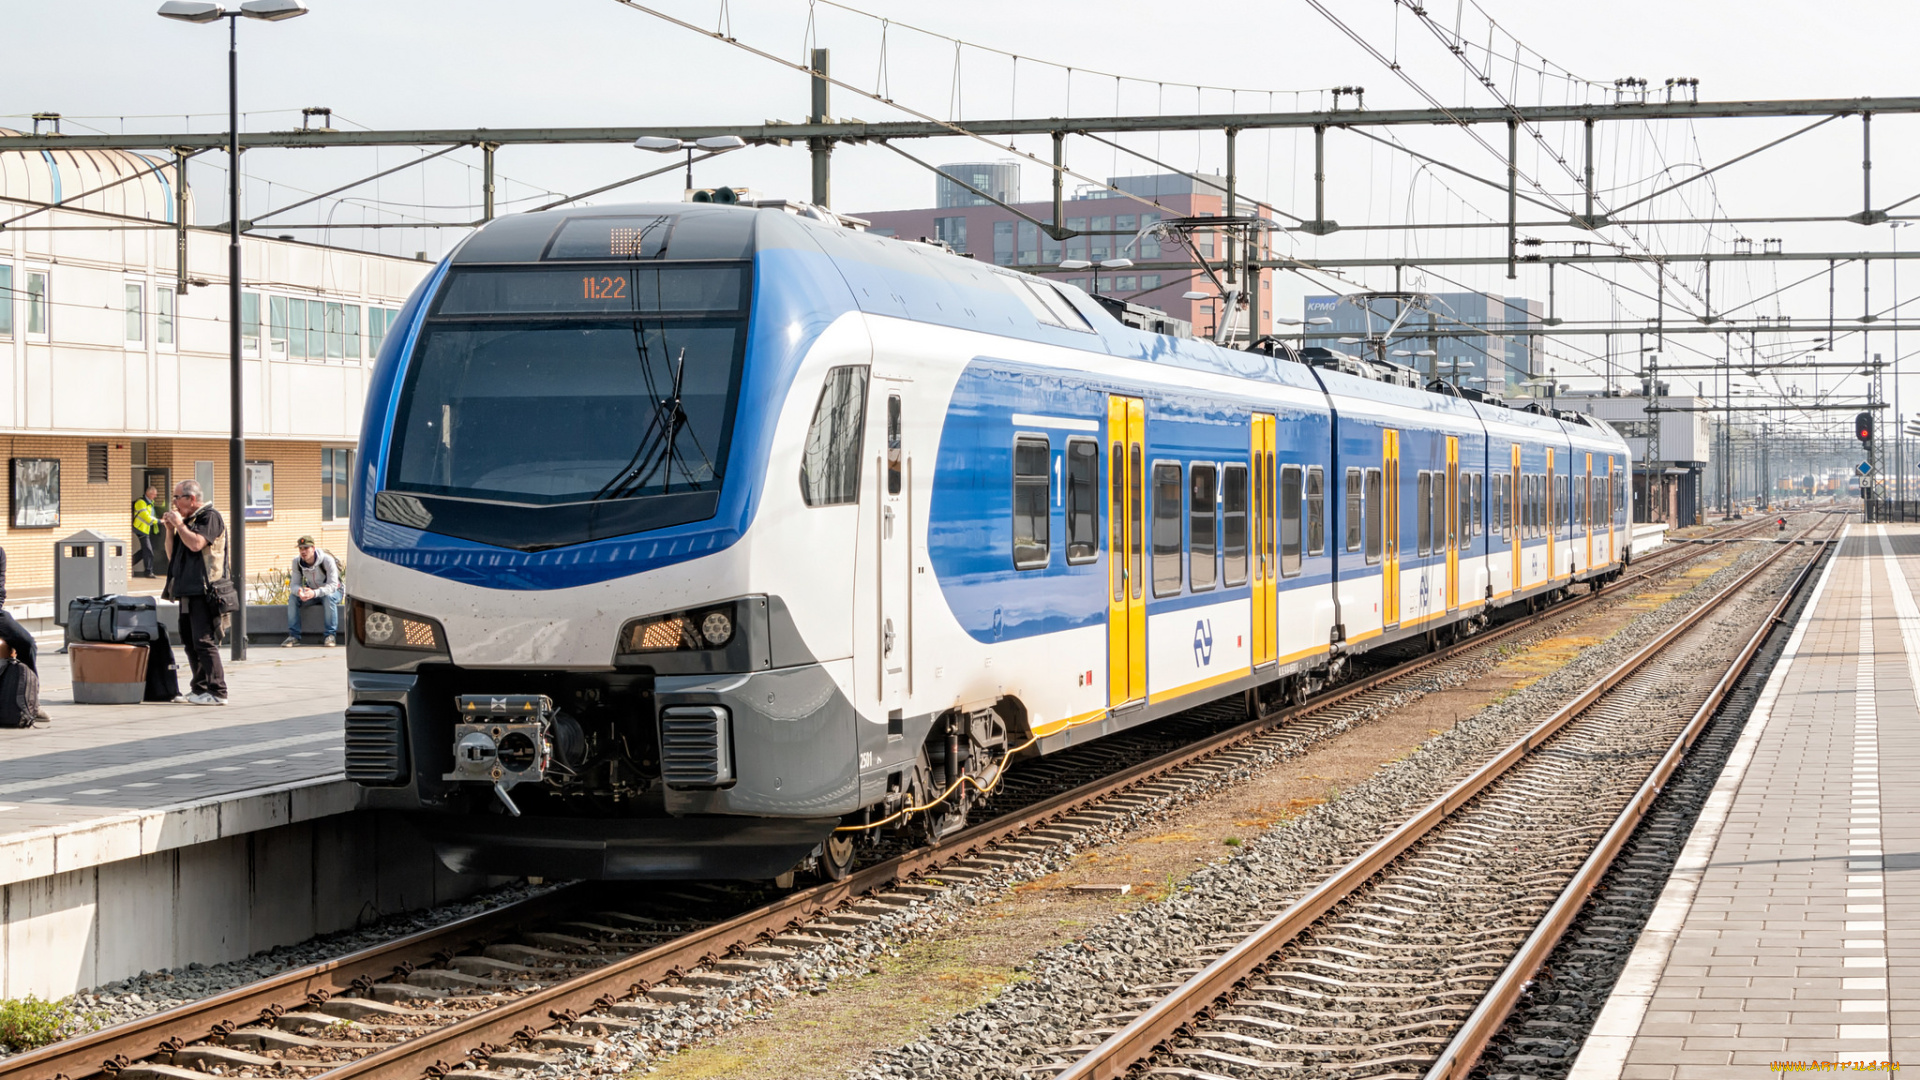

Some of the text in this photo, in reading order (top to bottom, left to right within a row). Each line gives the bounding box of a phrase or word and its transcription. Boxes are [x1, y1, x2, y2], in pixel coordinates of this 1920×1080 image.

[583, 277, 626, 298] 11:22
[1307, 302, 1336, 311] KPMG
[1054, 455, 1062, 507] 1
[1216, 462, 1222, 503] 2
[1862, 477, 1868, 487] 6
